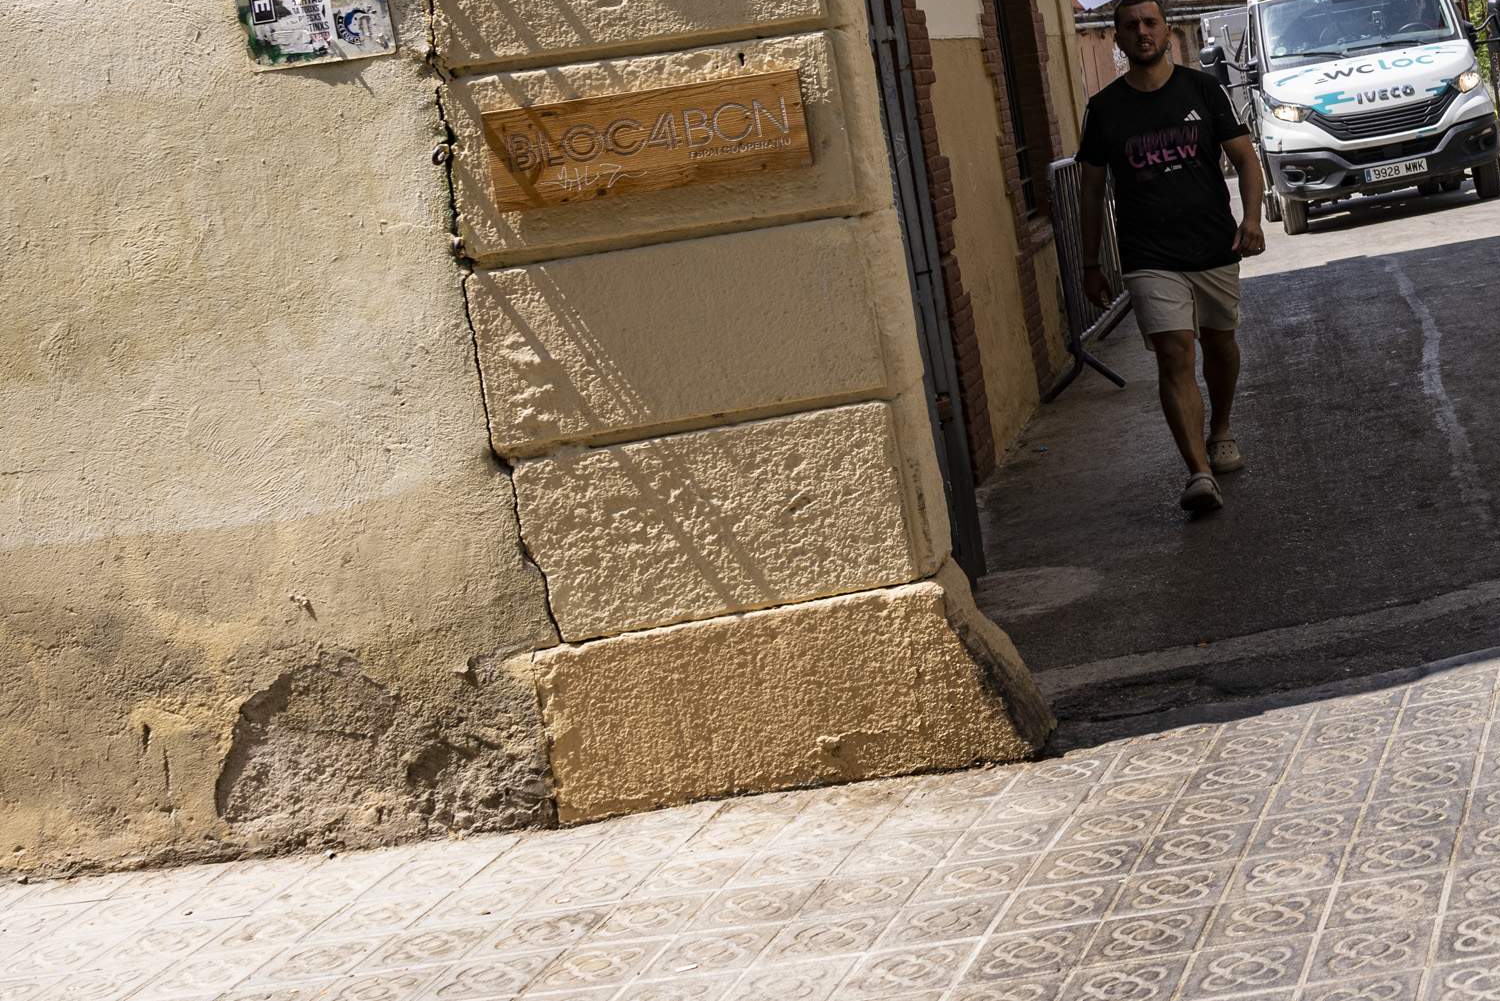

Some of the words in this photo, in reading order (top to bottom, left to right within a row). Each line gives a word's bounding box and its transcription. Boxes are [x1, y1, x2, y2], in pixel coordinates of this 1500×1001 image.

[1355, 83, 1416, 105] IVECO
[1128, 144, 1198, 169] CREW
[1373, 166, 1401, 180] 9928
[1404, 160, 1426, 175] MWK
